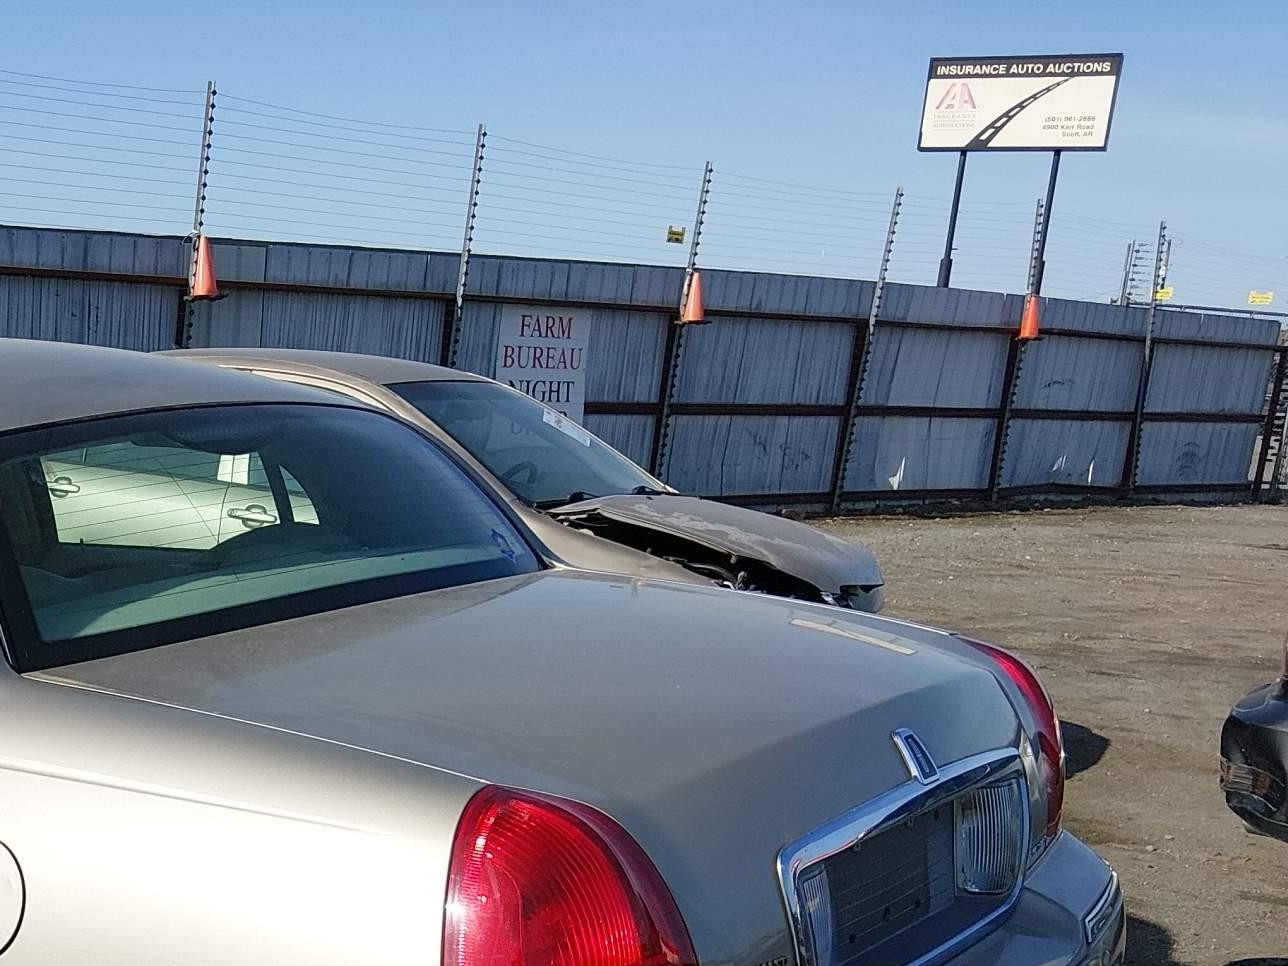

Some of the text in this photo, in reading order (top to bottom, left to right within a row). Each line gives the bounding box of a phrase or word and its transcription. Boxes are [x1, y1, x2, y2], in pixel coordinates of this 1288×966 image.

[936, 62, 1111, 75] INSURANCE AUTO AUCTIONS
[519, 314, 574, 339] FARM
[502, 345, 584, 370] BUREAU
